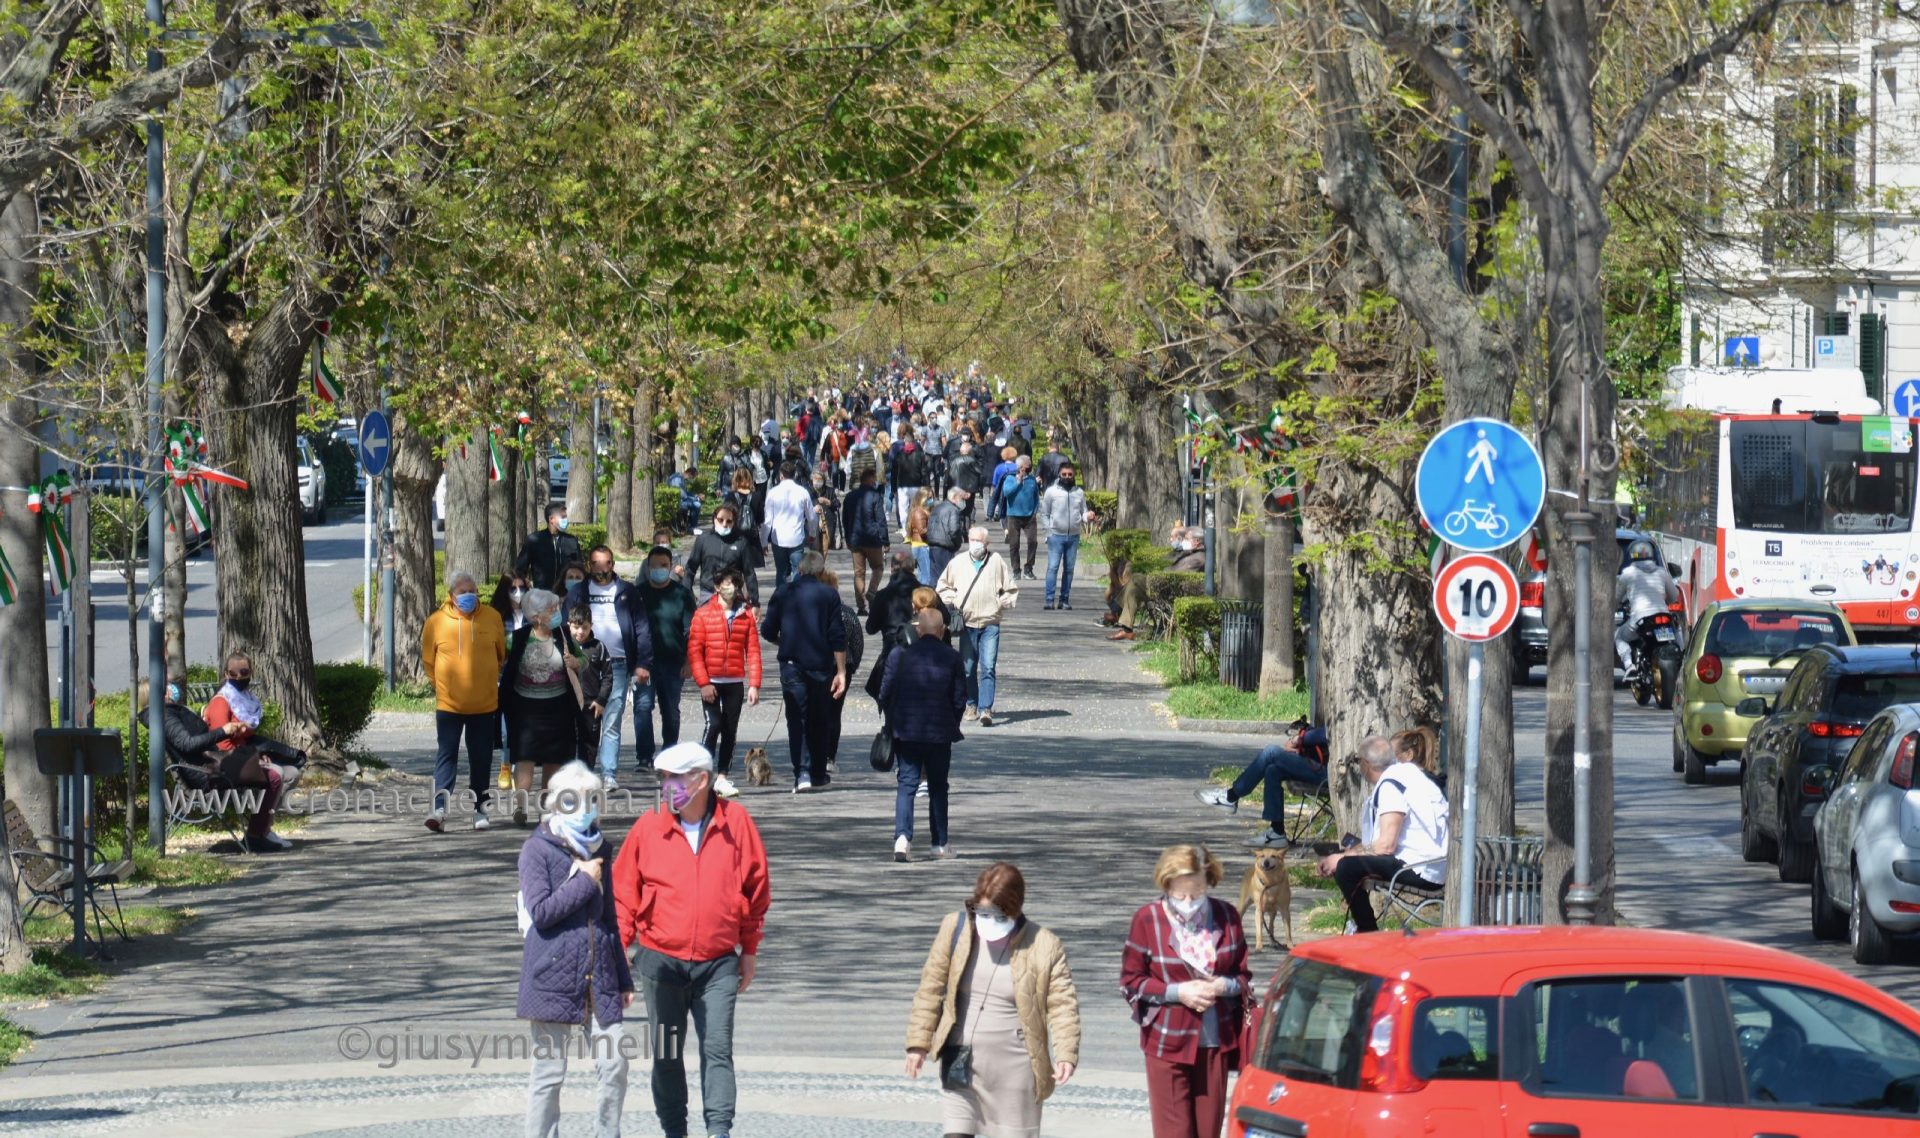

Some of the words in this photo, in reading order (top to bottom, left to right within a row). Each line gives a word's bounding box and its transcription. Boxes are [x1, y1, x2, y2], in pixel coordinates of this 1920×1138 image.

[1820, 340, 1831, 354] P
[1767, 543, 1781, 553] T5
[1459, 578, 1497, 618] 10
